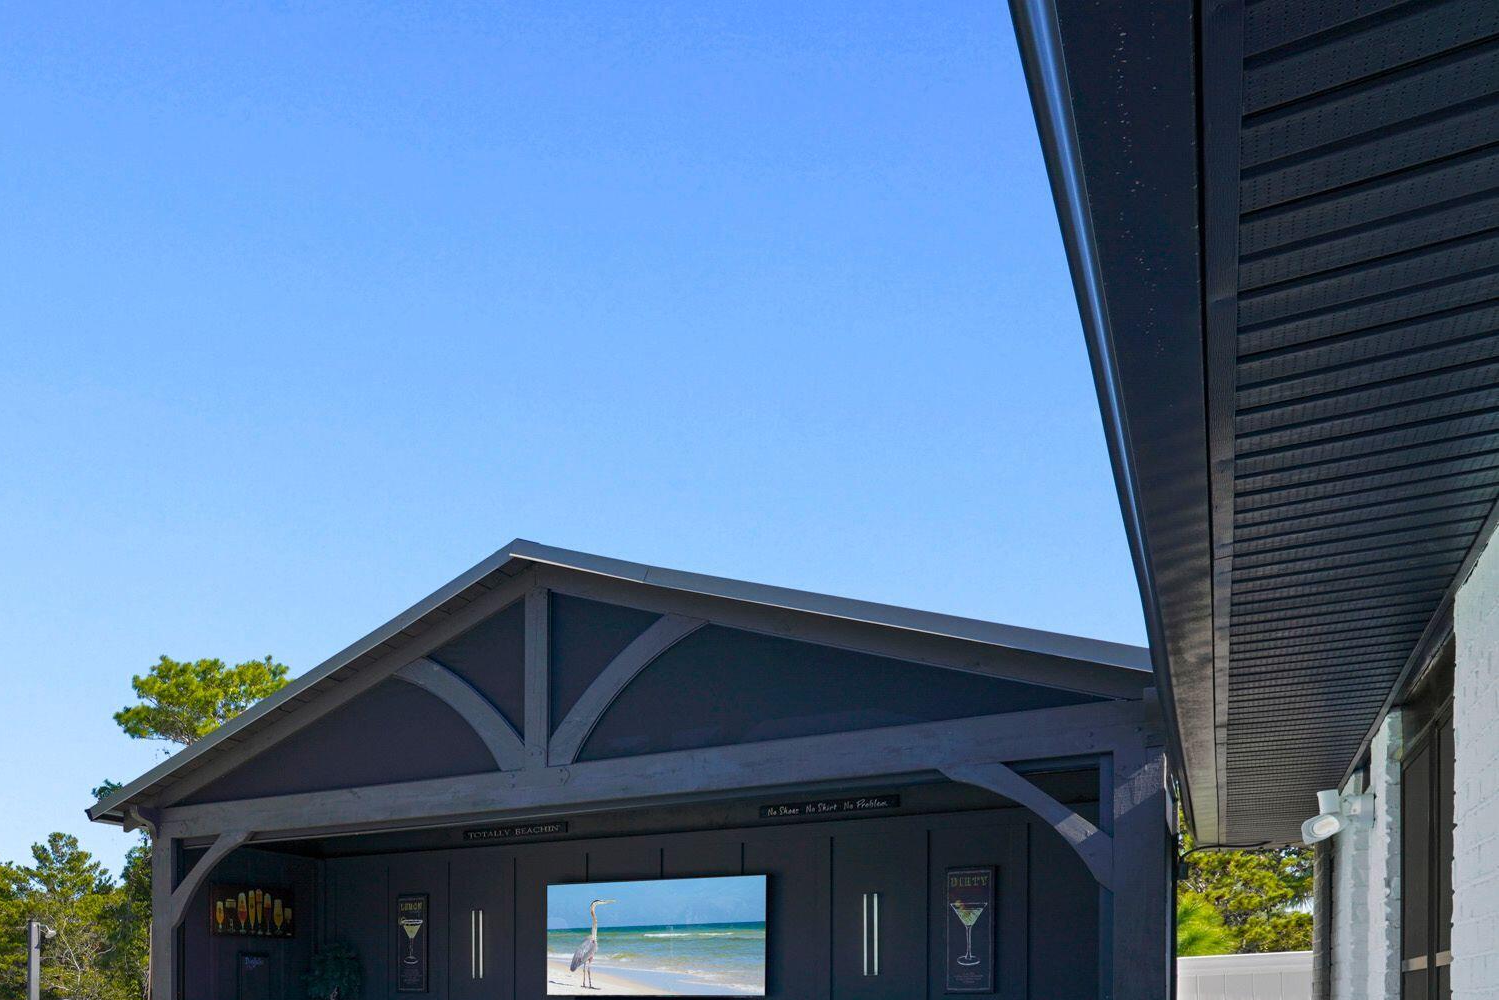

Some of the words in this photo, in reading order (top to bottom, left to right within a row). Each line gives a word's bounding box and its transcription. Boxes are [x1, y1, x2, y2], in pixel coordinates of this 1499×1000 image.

[767, 807, 777, 817] No
[779, 806, 800, 816] Shoes
[805, 804, 816, 814] No
[817, 802, 837, 813] Shirt
[843, 801, 854, 811] No
[856, 798, 888, 809] Problem
[467, 829, 511, 839] TOTALLY
[950, 875, 989, 887] DIRTY
